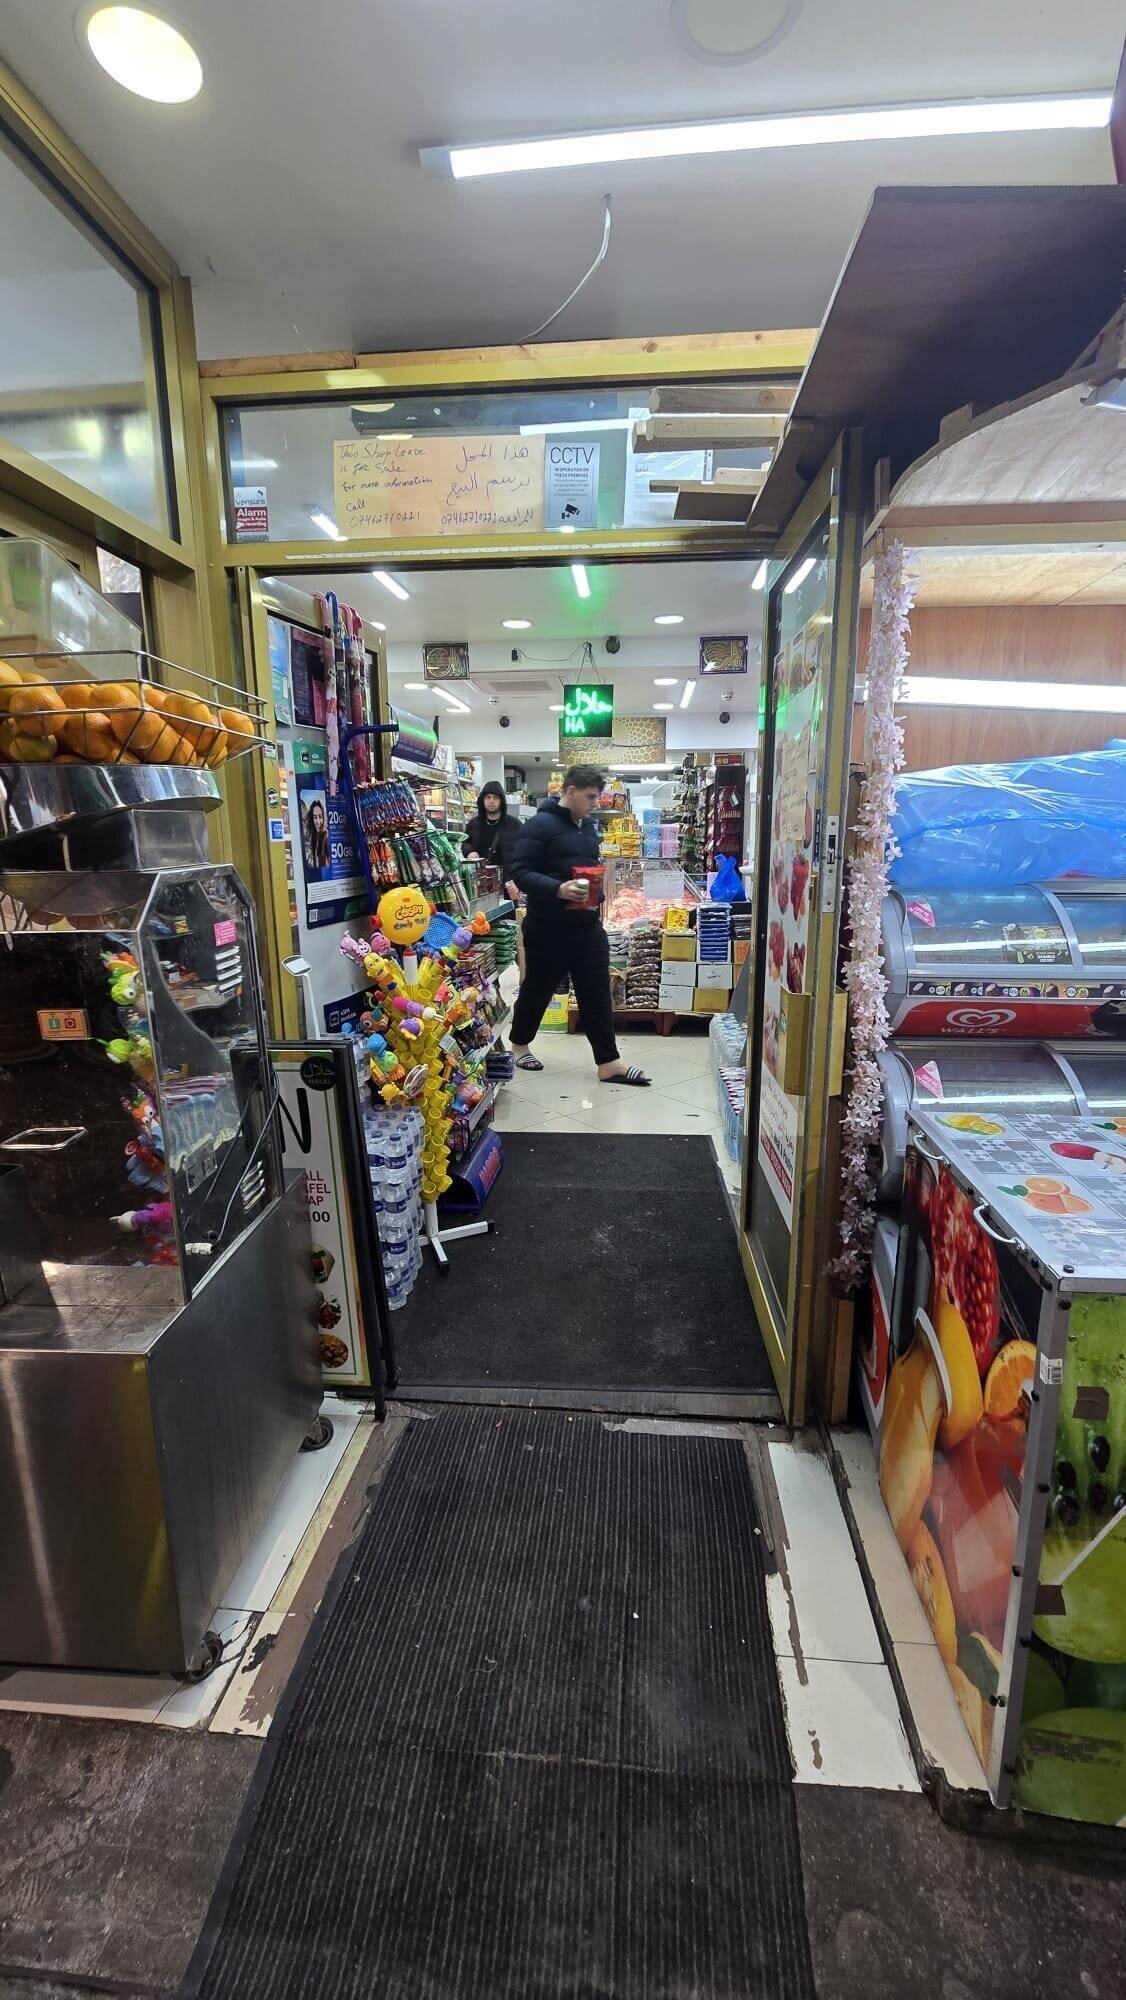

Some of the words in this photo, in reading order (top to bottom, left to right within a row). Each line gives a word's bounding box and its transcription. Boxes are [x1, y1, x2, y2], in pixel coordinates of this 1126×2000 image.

[337, 443, 359, 460] This
[363, 442, 392, 465] Shop
[550, 446, 594, 464] CCTV
[375, 460, 407, 474] Sale
[384, 476, 433, 488] information
[237, 508, 267, 517] Alarm
[308, 1077, 332, 1085] HALAL
